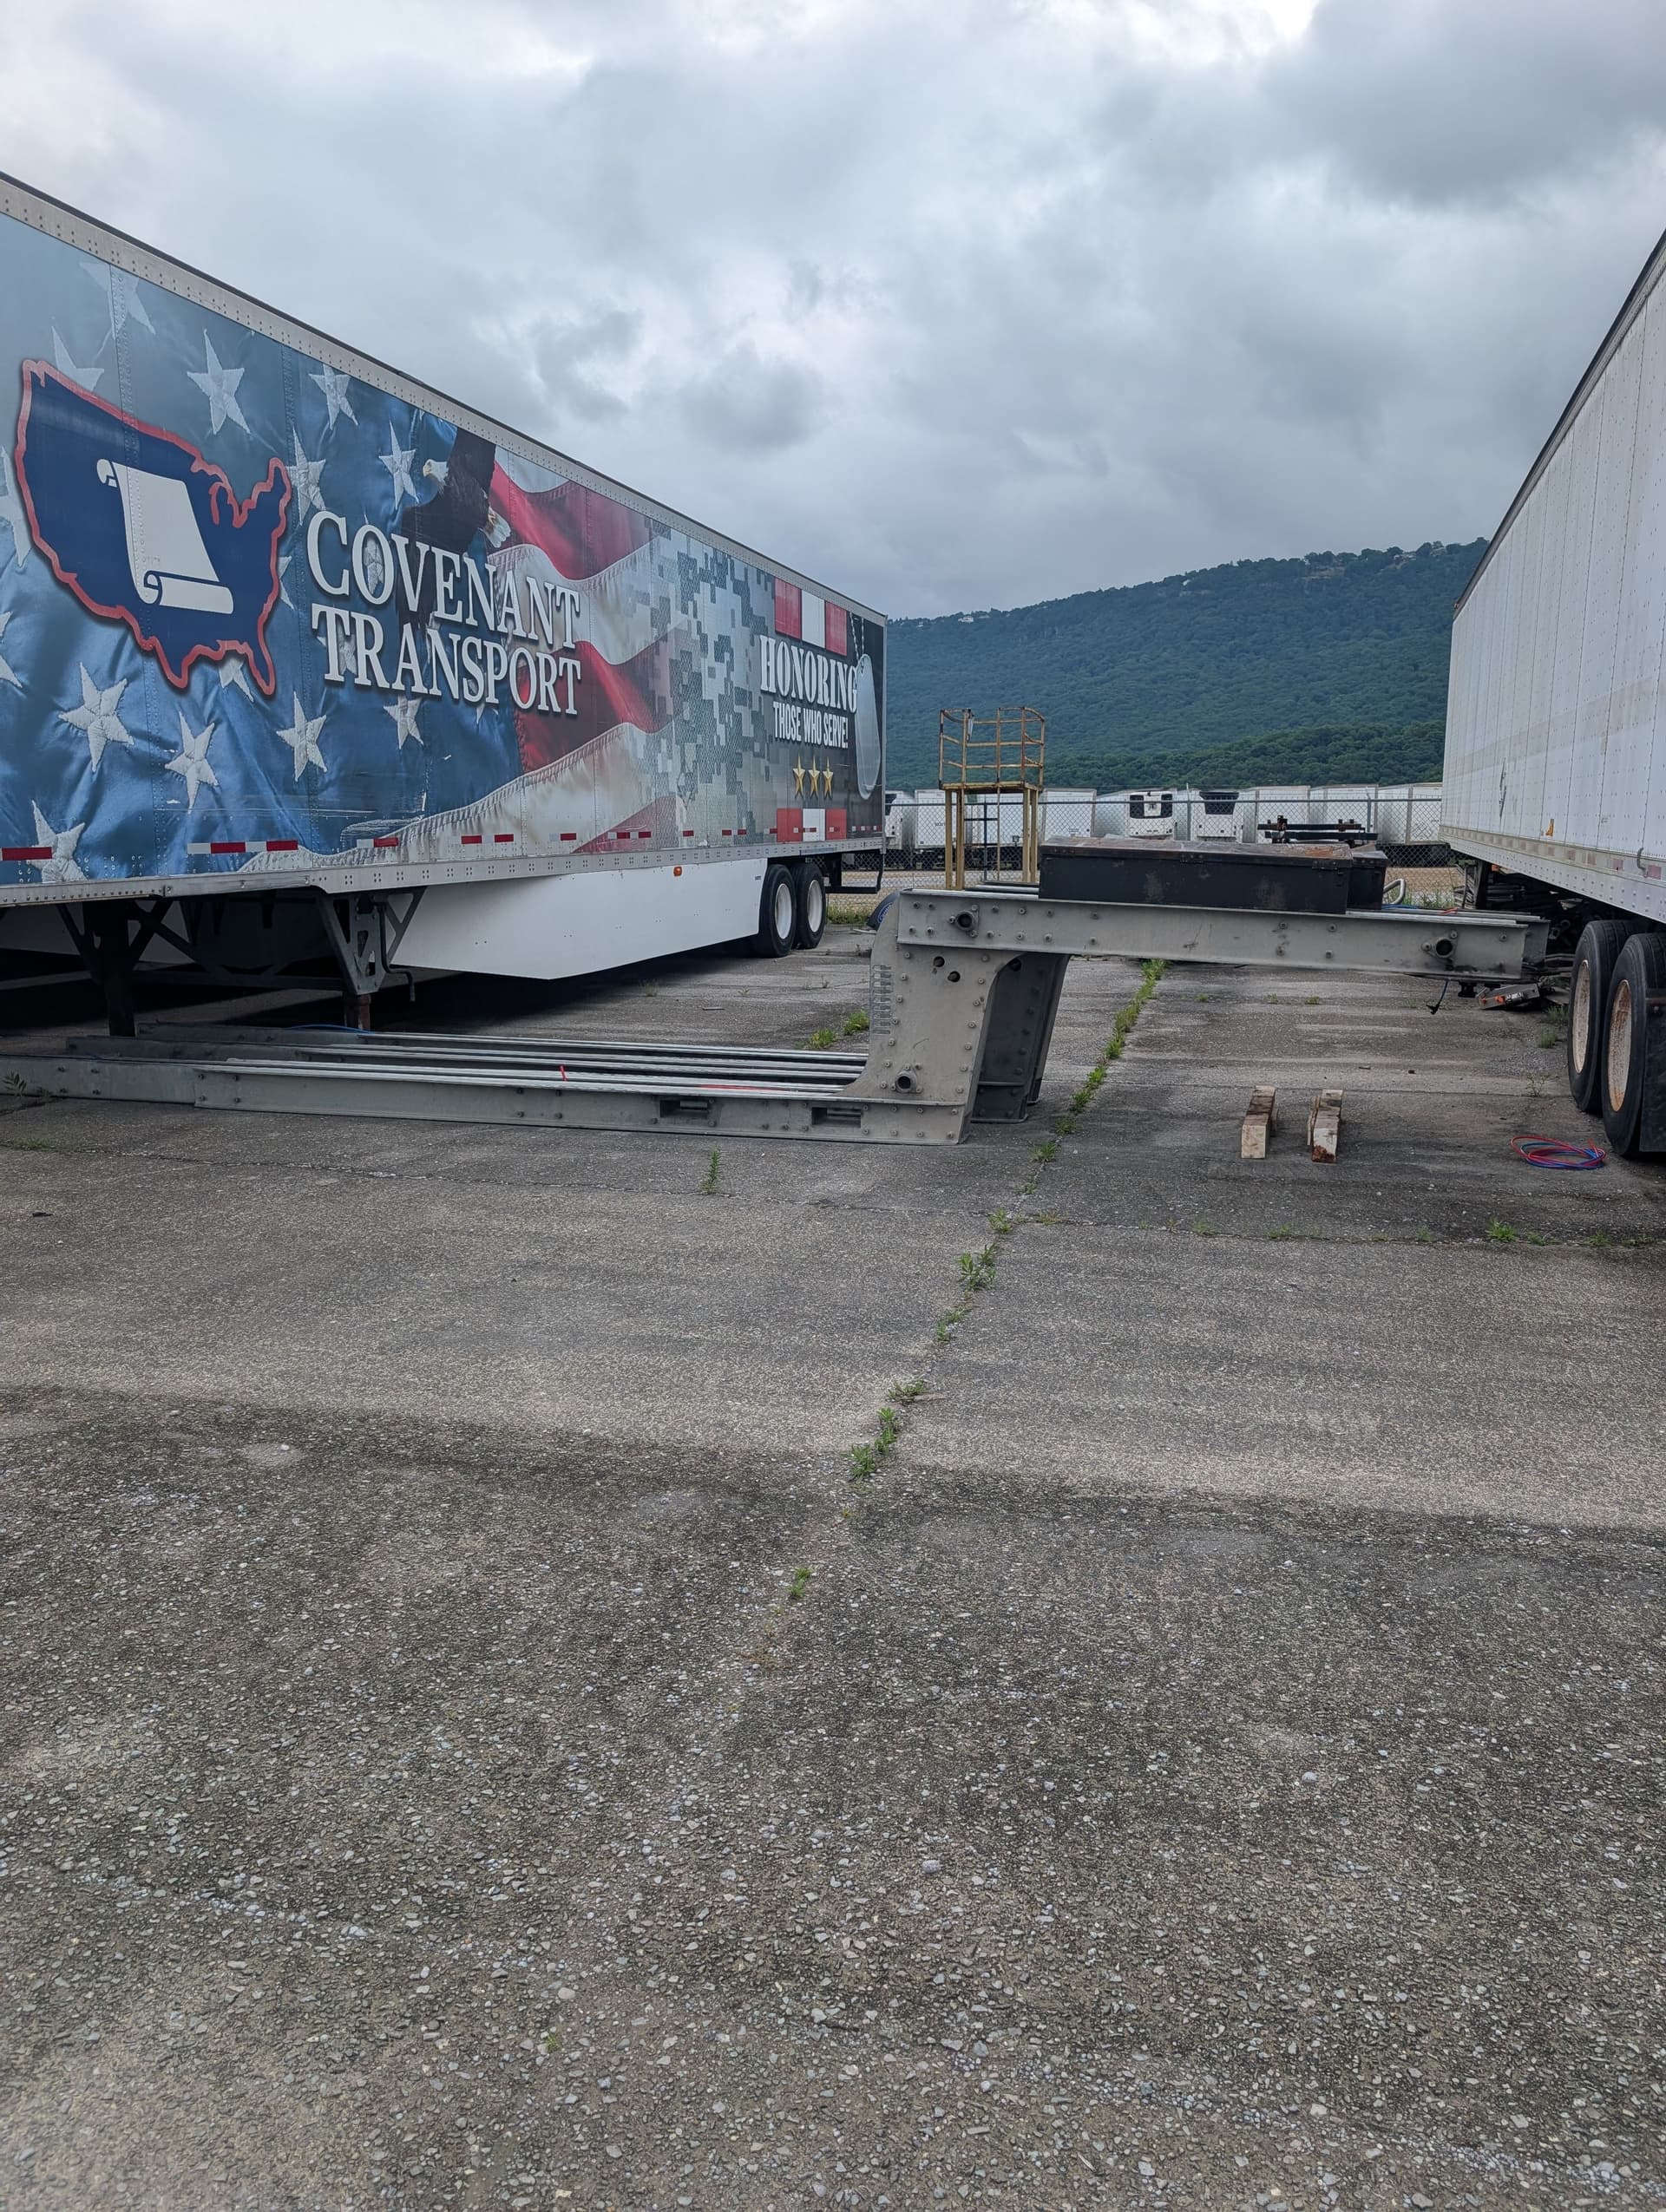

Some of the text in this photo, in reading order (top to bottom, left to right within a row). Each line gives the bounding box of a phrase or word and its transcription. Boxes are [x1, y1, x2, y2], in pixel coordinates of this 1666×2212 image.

[306, 510, 580, 649] COVENANT
[312, 603, 581, 715] TRANSPORT
[759, 635, 857, 713] HONORING
[773, 701, 848, 749] THOSE WHO SERVE!
